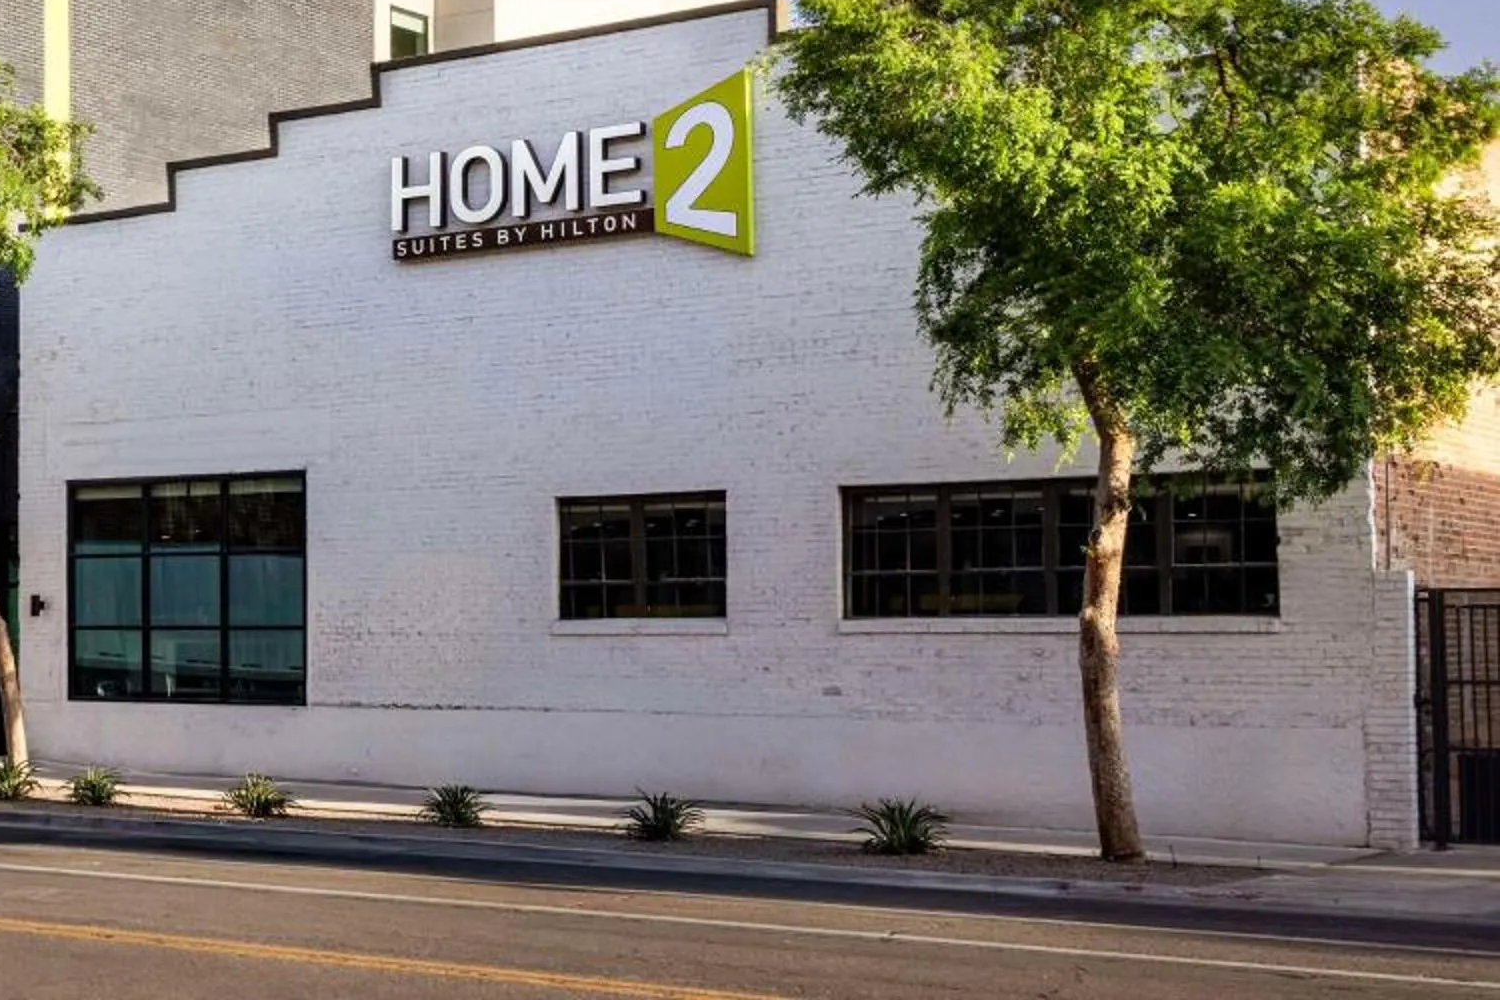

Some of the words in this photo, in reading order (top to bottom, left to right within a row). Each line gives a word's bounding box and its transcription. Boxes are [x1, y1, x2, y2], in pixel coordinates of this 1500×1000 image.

[391, 121, 643, 232] HOME
[664, 101, 738, 238] 2
[396, 231, 484, 258] SUITES
[497, 226, 528, 246] BY
[540, 212, 637, 241] HILTON
